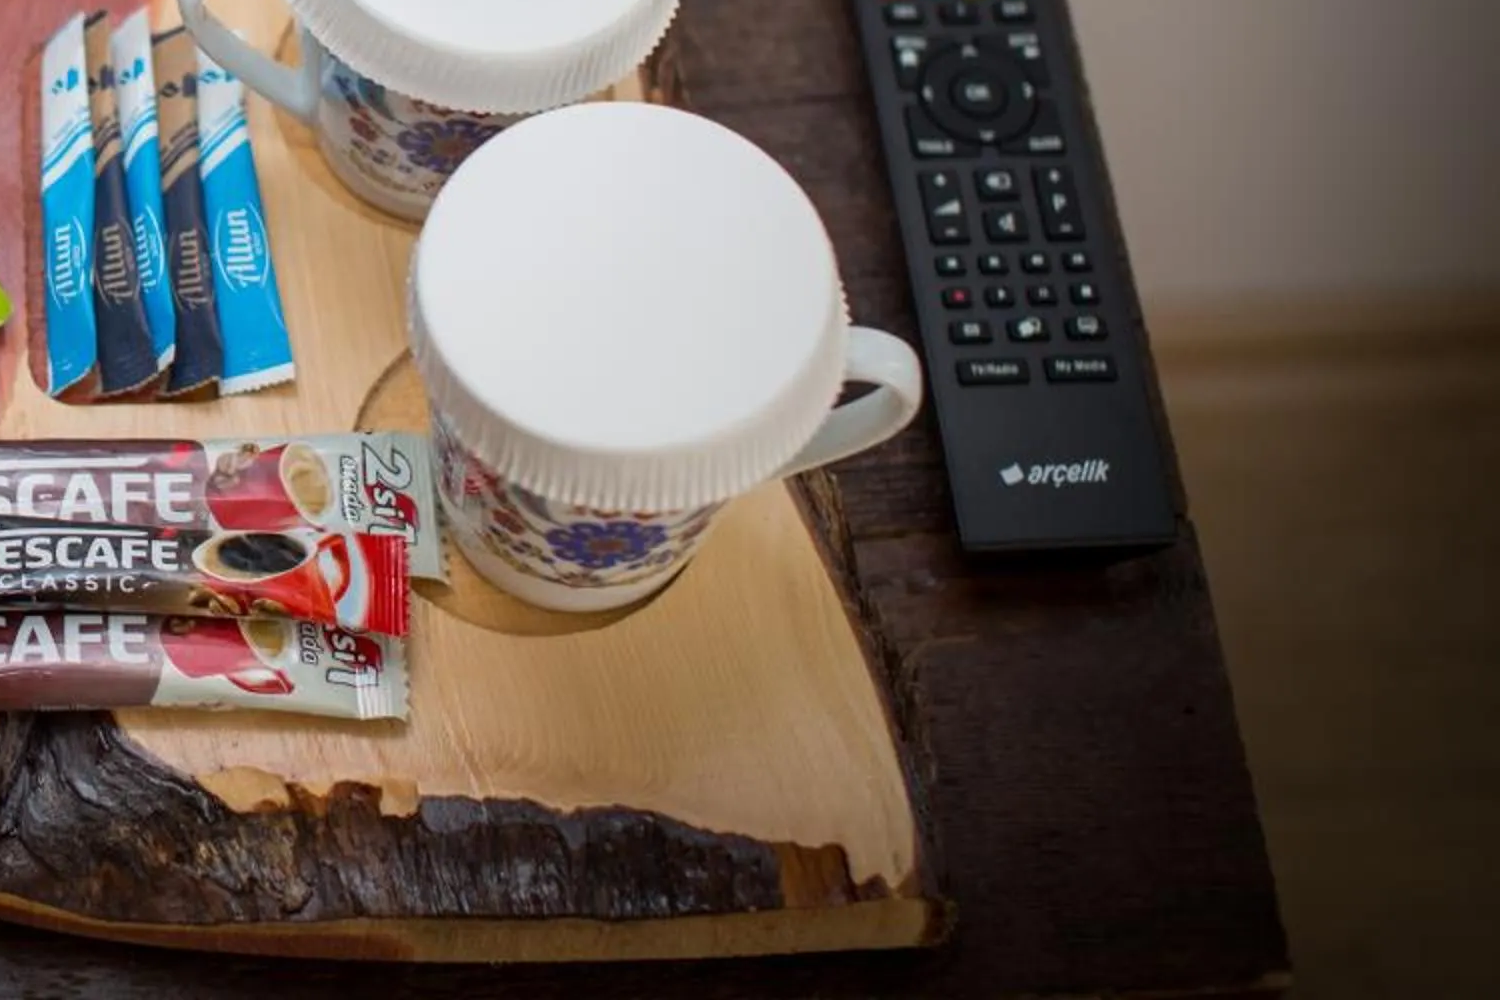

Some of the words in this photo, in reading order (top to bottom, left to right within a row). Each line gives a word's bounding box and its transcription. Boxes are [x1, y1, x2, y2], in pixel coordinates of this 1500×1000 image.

[1028, 459, 1110, 488] arçelik
[0, 573, 136, 593] CLASSIC
[300, 621, 323, 666] ada
